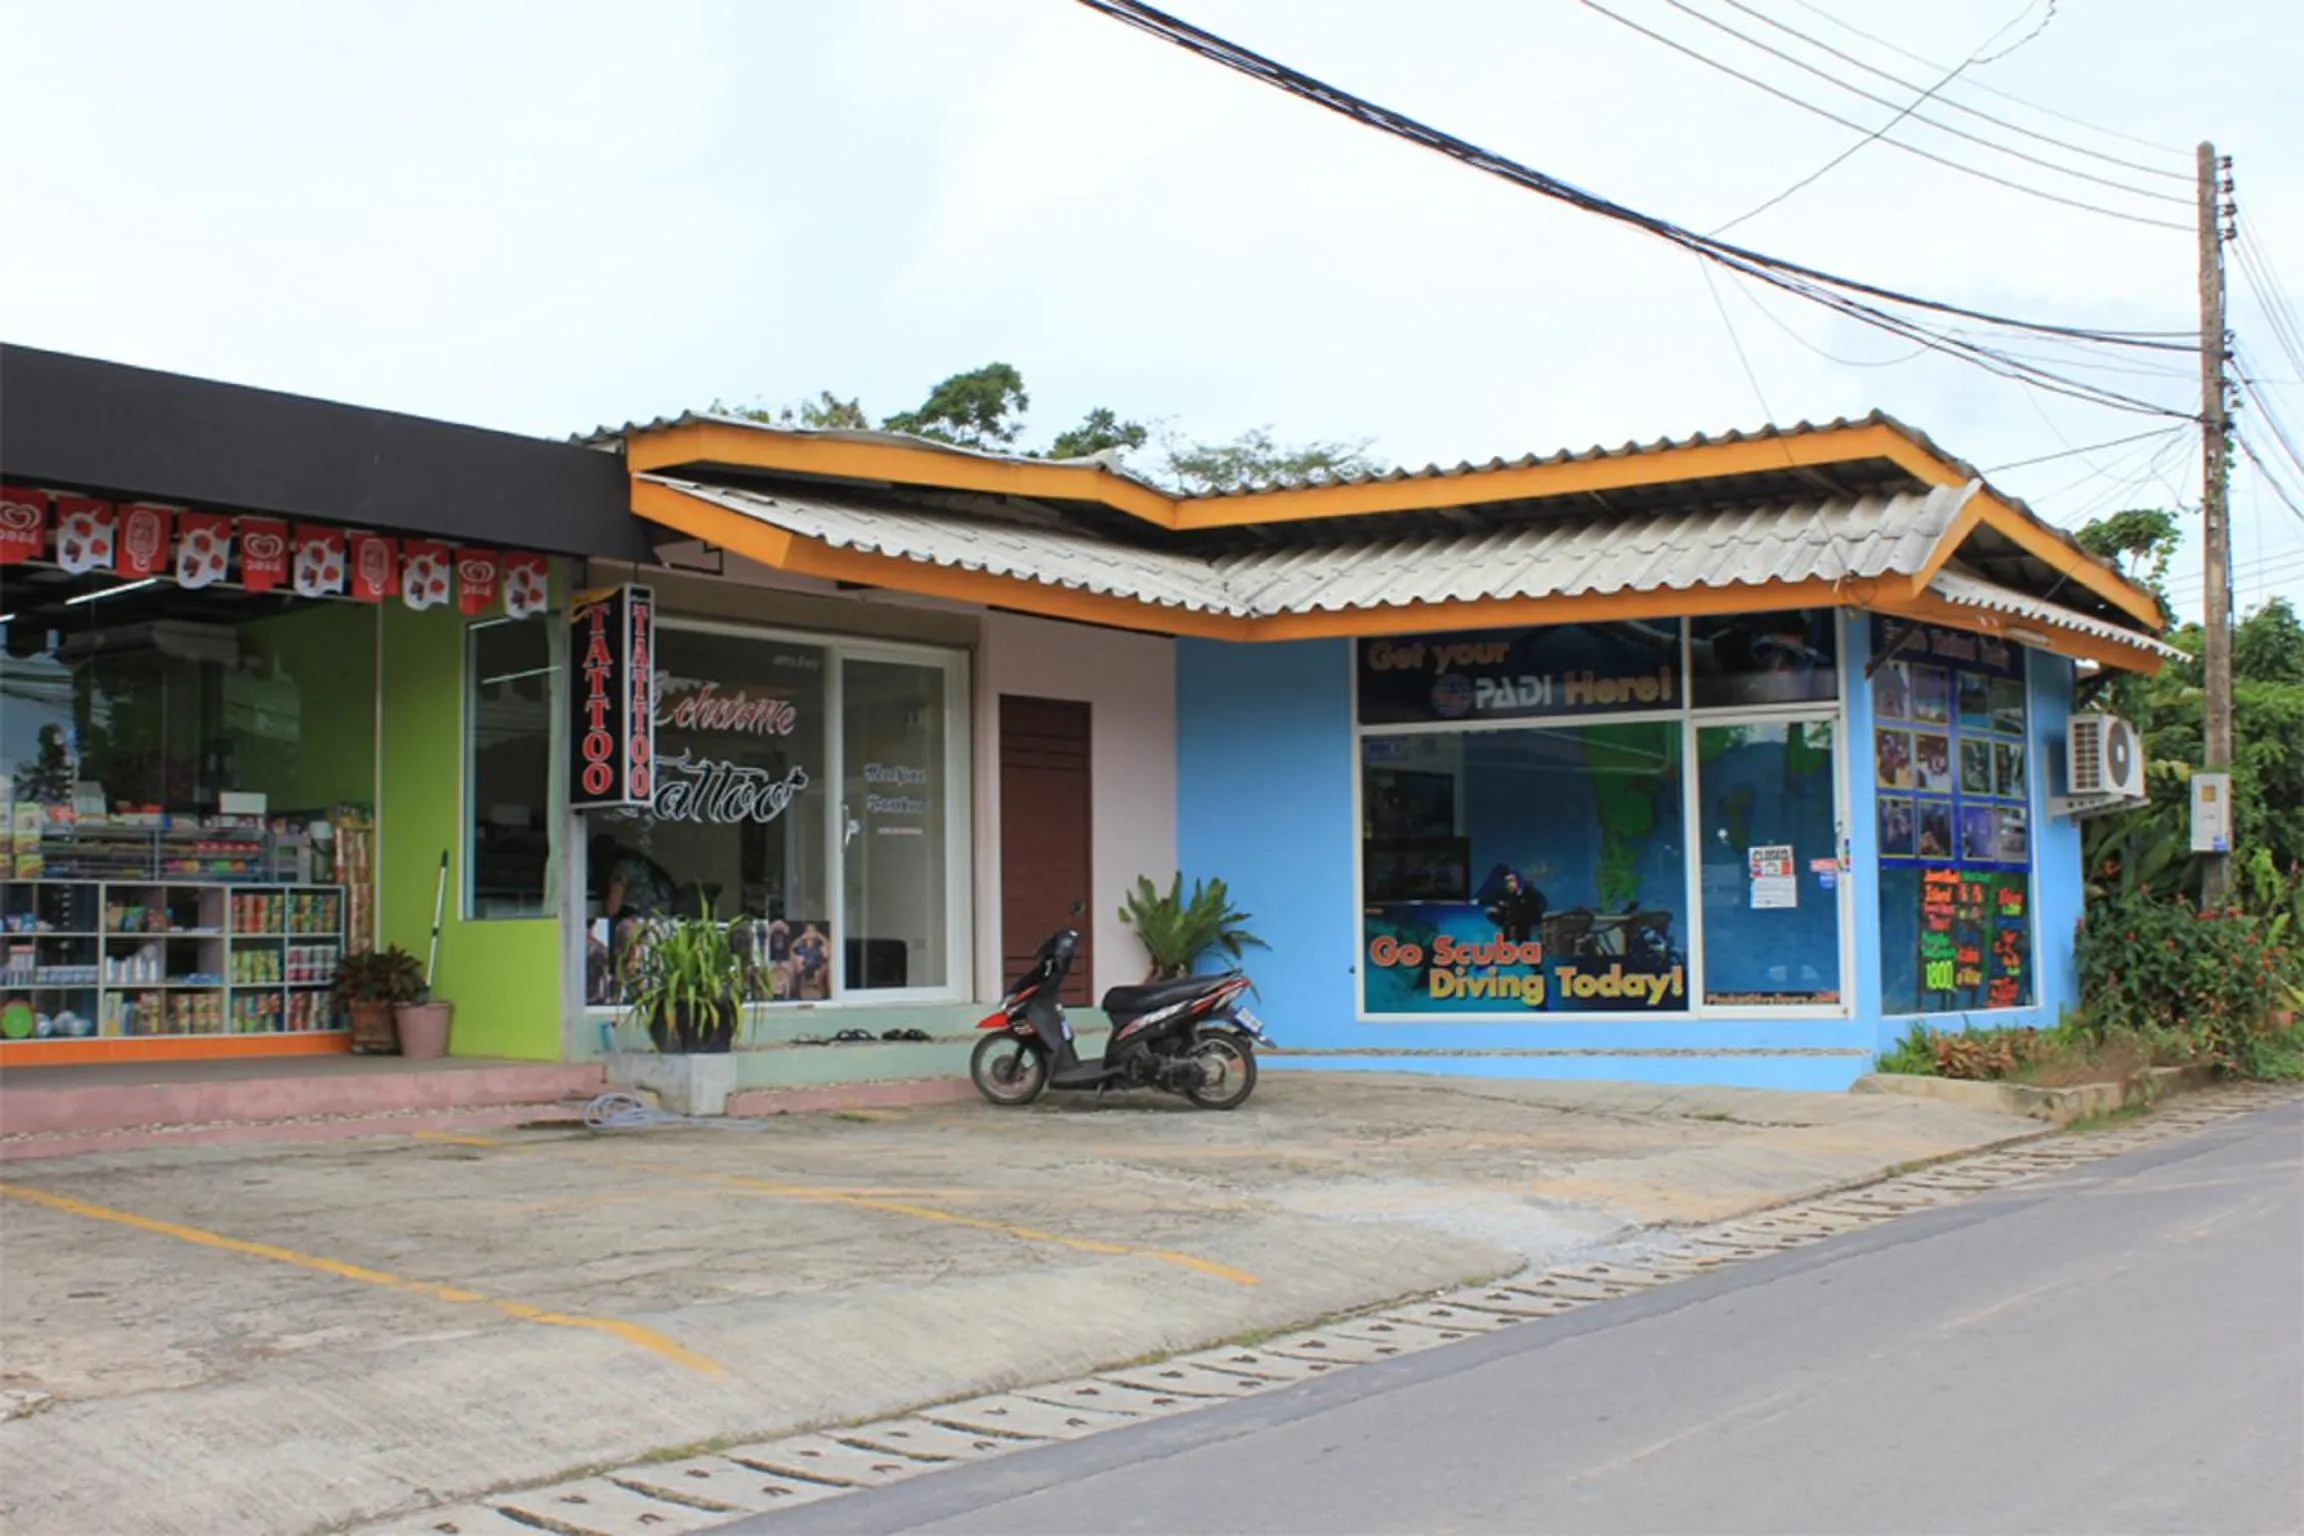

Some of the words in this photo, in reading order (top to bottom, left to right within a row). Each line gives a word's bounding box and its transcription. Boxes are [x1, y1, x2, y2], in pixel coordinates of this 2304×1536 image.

[1368, 640, 1427, 672] Get
[1433, 641, 1510, 675] your
[582, 602, 614, 795] TATTOO
[630, 604, 650, 797] TATTOO
[1474, 674, 1553, 710] PADI
[1563, 665, 1674, 706] Here!
[1369, 936, 1423, 966] Go
[1432, 934, 1542, 966] Scuba
[1429, 966, 1545, 1006] Diving
[1554, 962, 1684, 1006] Today!
